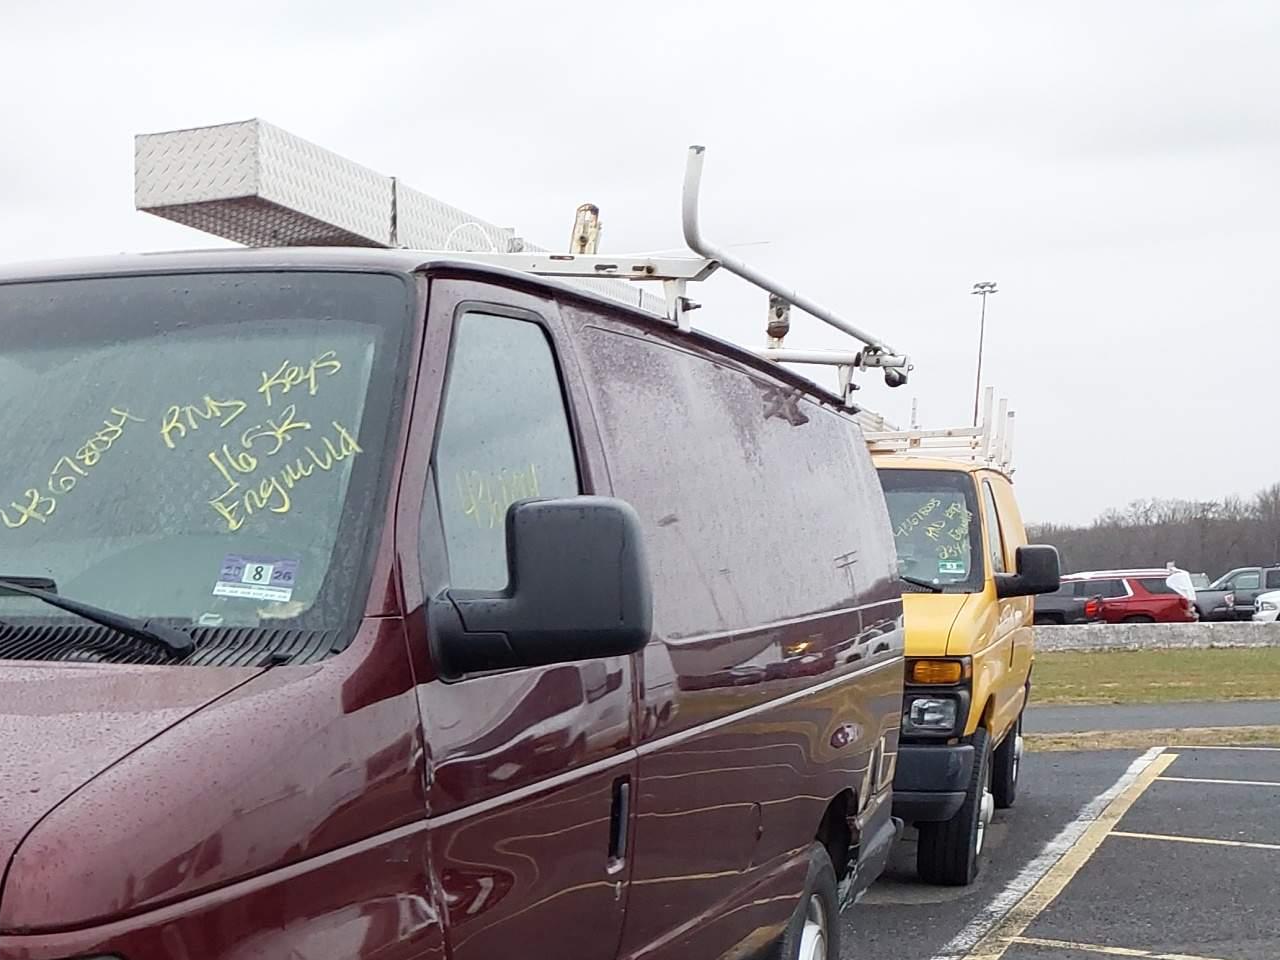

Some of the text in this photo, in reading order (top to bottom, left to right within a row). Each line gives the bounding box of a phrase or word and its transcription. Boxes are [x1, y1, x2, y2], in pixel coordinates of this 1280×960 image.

[257, 350, 343, 406] Keys
[252, 565, 265, 581] 8
[272, 570, 293, 582] 26
